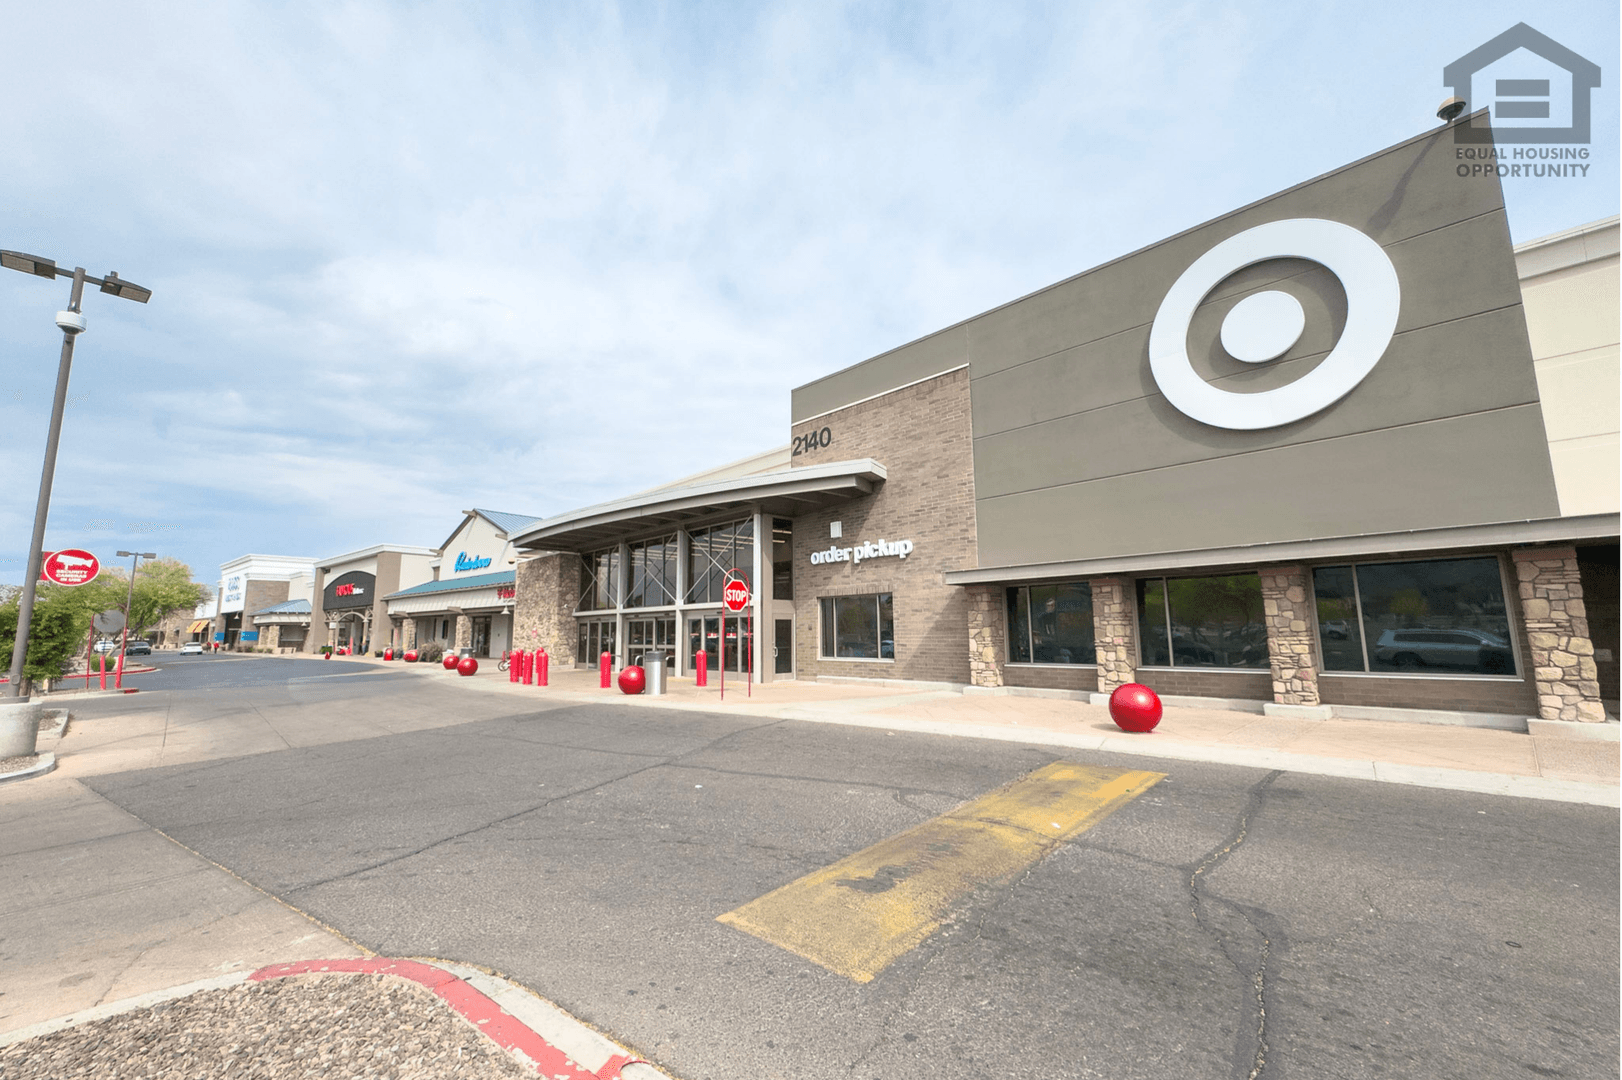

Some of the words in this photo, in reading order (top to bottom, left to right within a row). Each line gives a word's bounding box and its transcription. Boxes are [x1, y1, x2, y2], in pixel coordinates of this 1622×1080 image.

[792, 427, 832, 457] 2140
[810, 545, 853, 565] order
[853, 538, 914, 564] pickup
[726, 589, 747, 602] STOP
